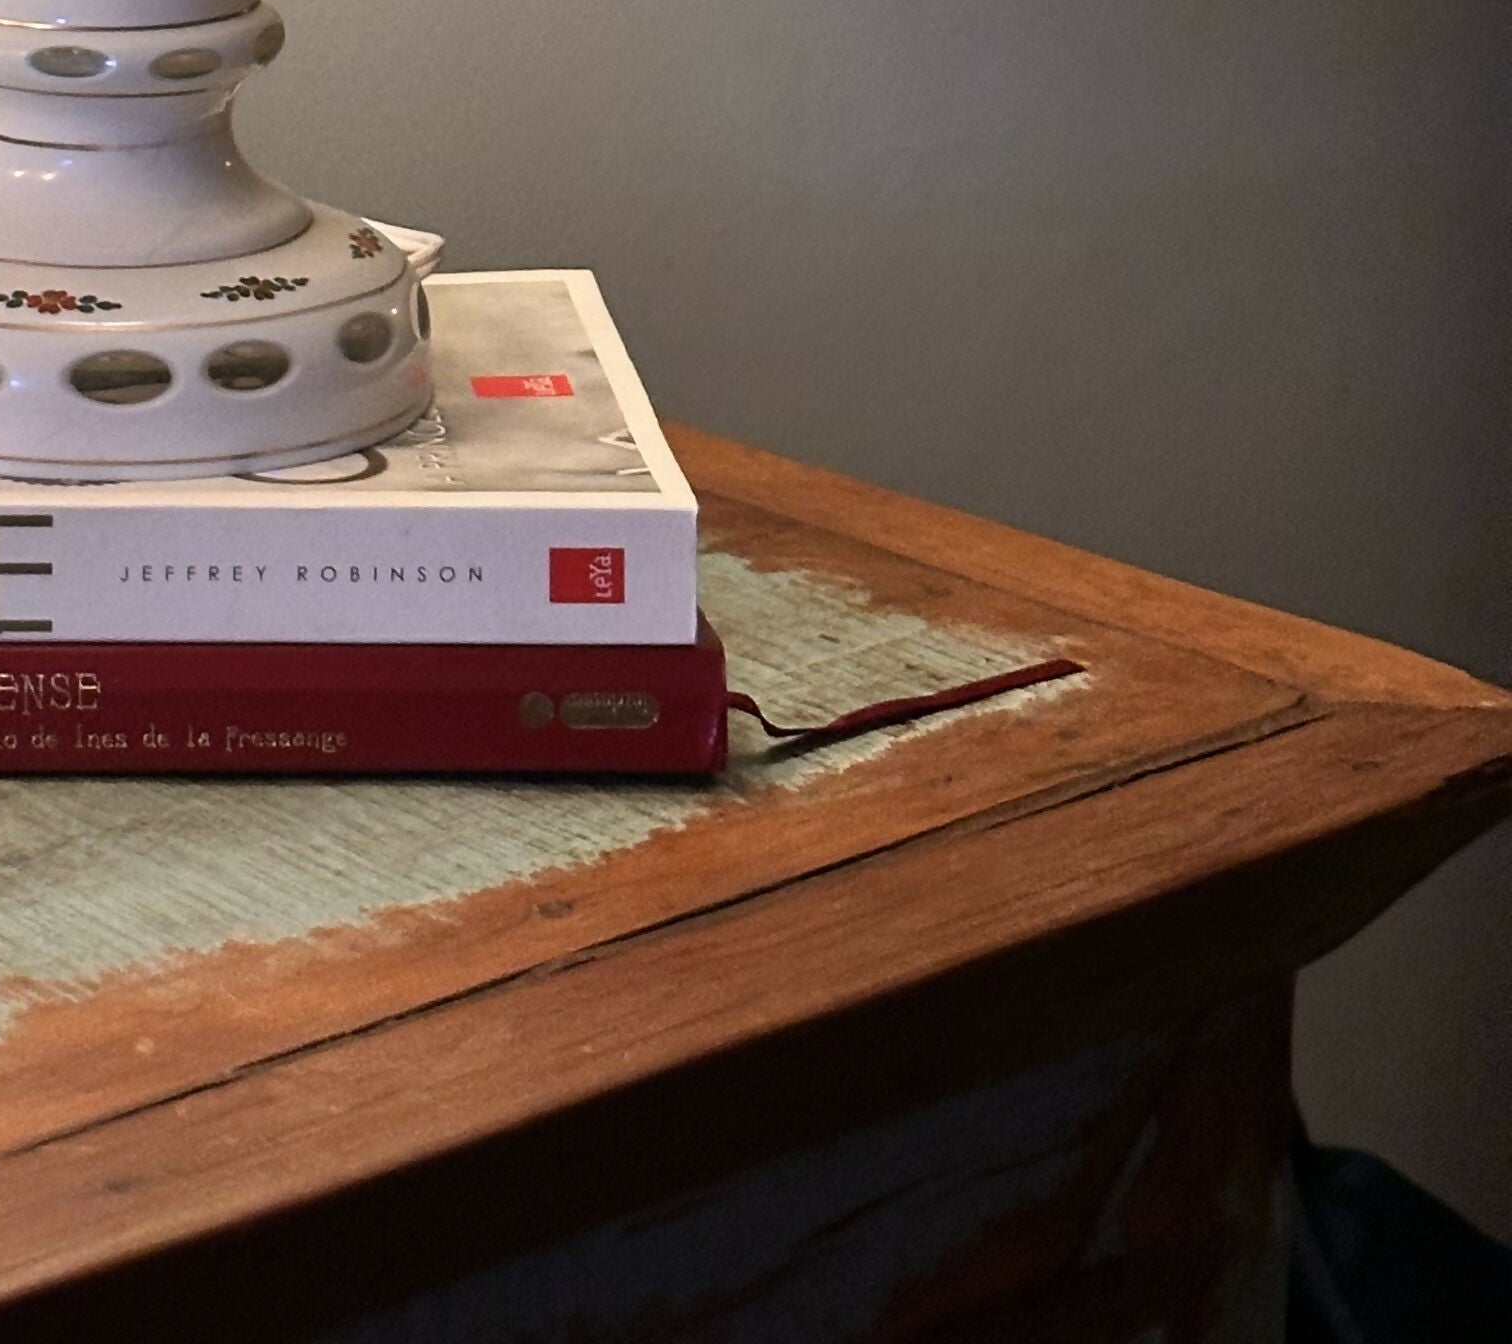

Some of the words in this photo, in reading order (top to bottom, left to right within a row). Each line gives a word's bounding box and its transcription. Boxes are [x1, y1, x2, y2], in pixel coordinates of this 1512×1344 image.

[120, 564, 267, 583] JEFFREY
[296, 564, 484, 583] ROBINSON
[31, 724, 58, 750] de
[142, 722, 170, 749] de
[187, 723, 211, 749] la
